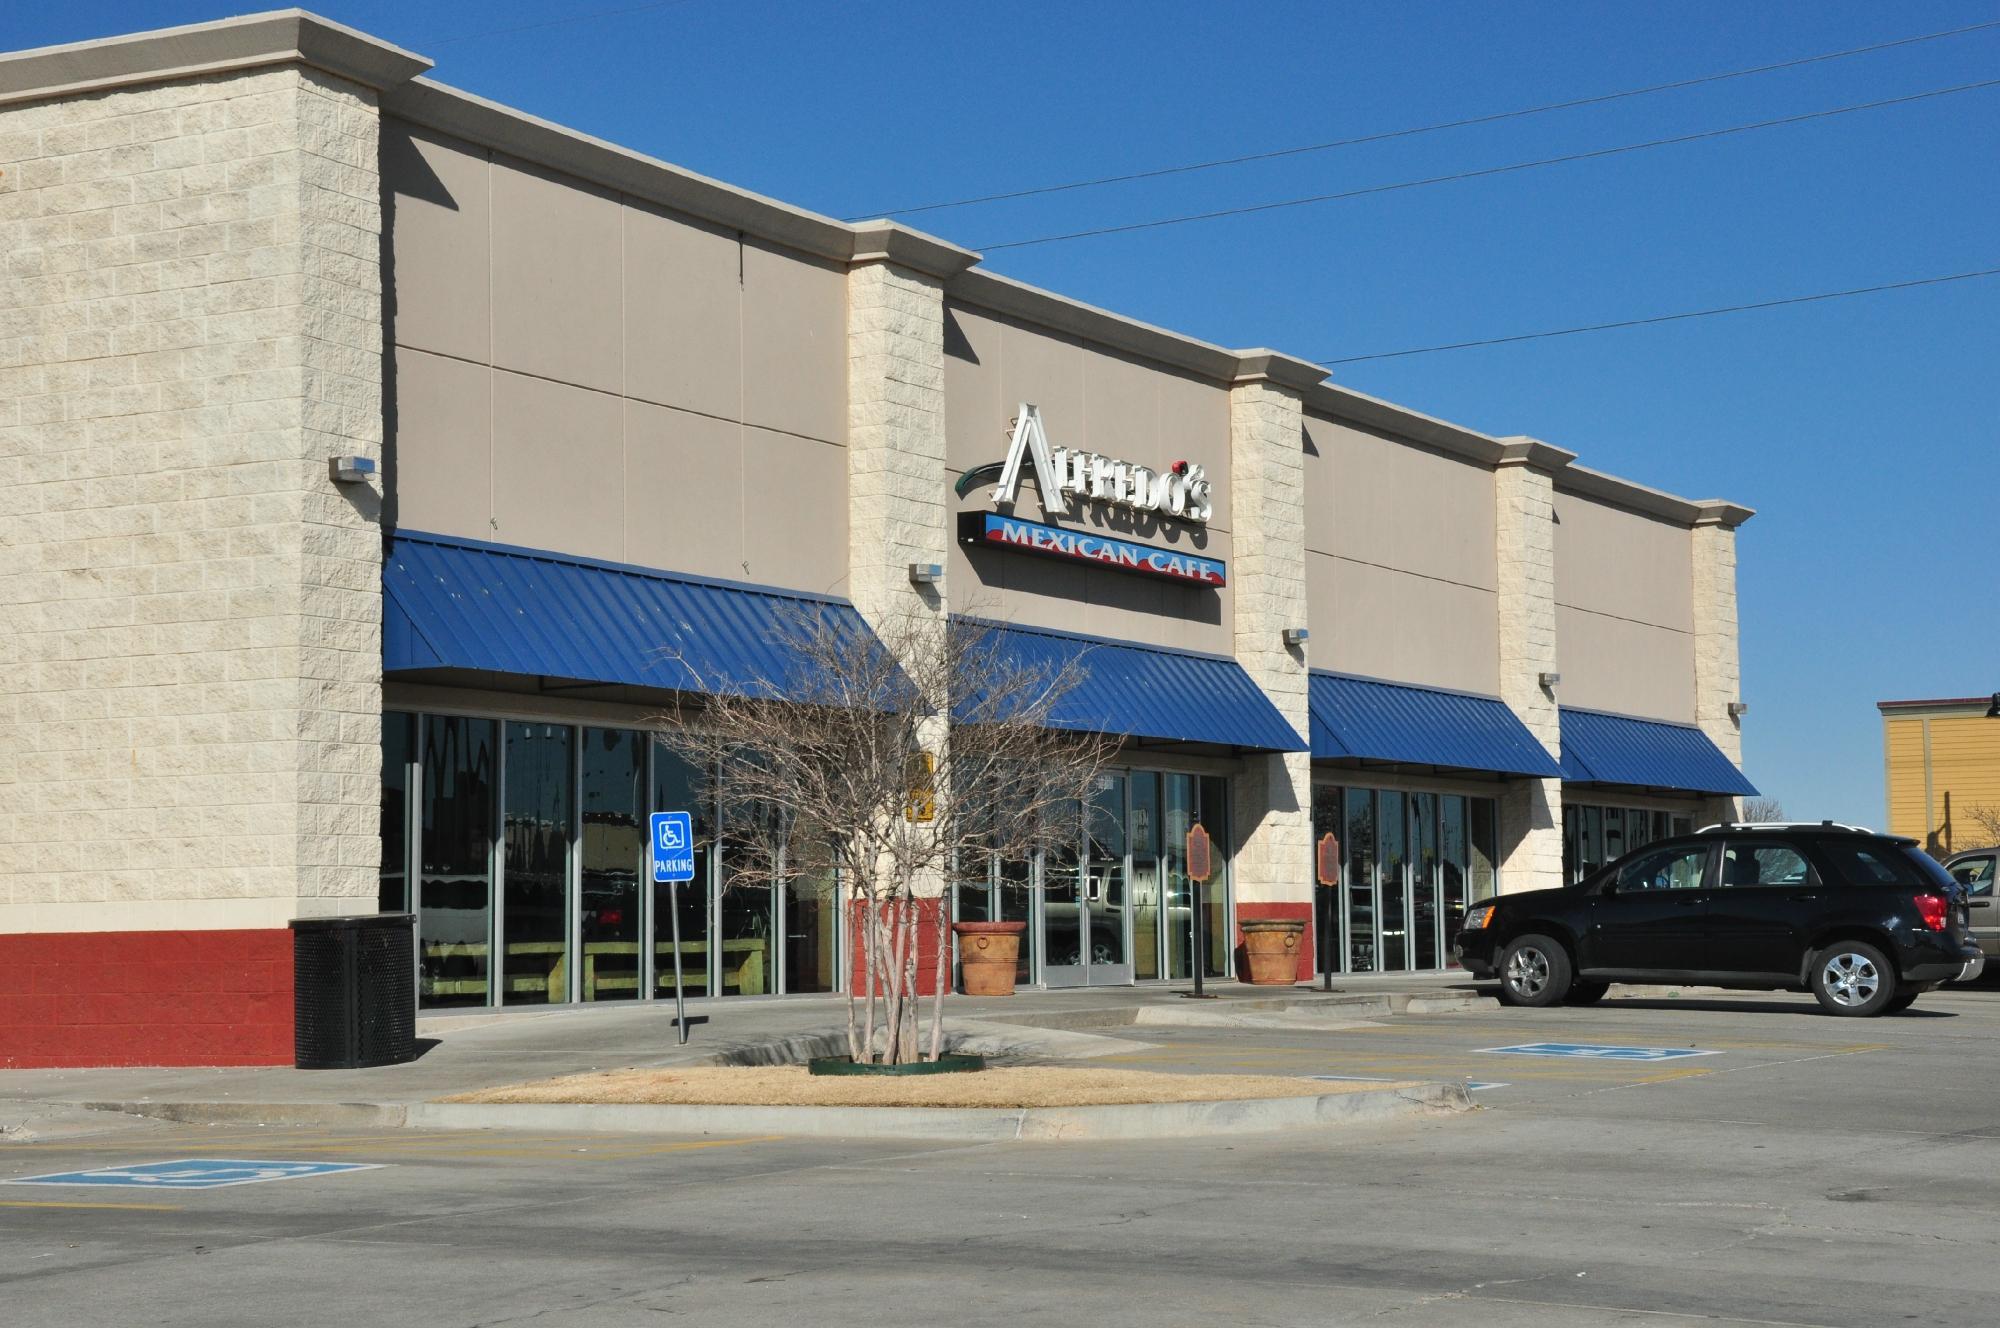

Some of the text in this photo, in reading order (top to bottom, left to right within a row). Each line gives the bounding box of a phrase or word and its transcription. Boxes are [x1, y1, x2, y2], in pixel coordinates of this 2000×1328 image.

[1001, 522, 1213, 582] MEXICAN CAFE
[655, 859, 692, 873] PARKING
